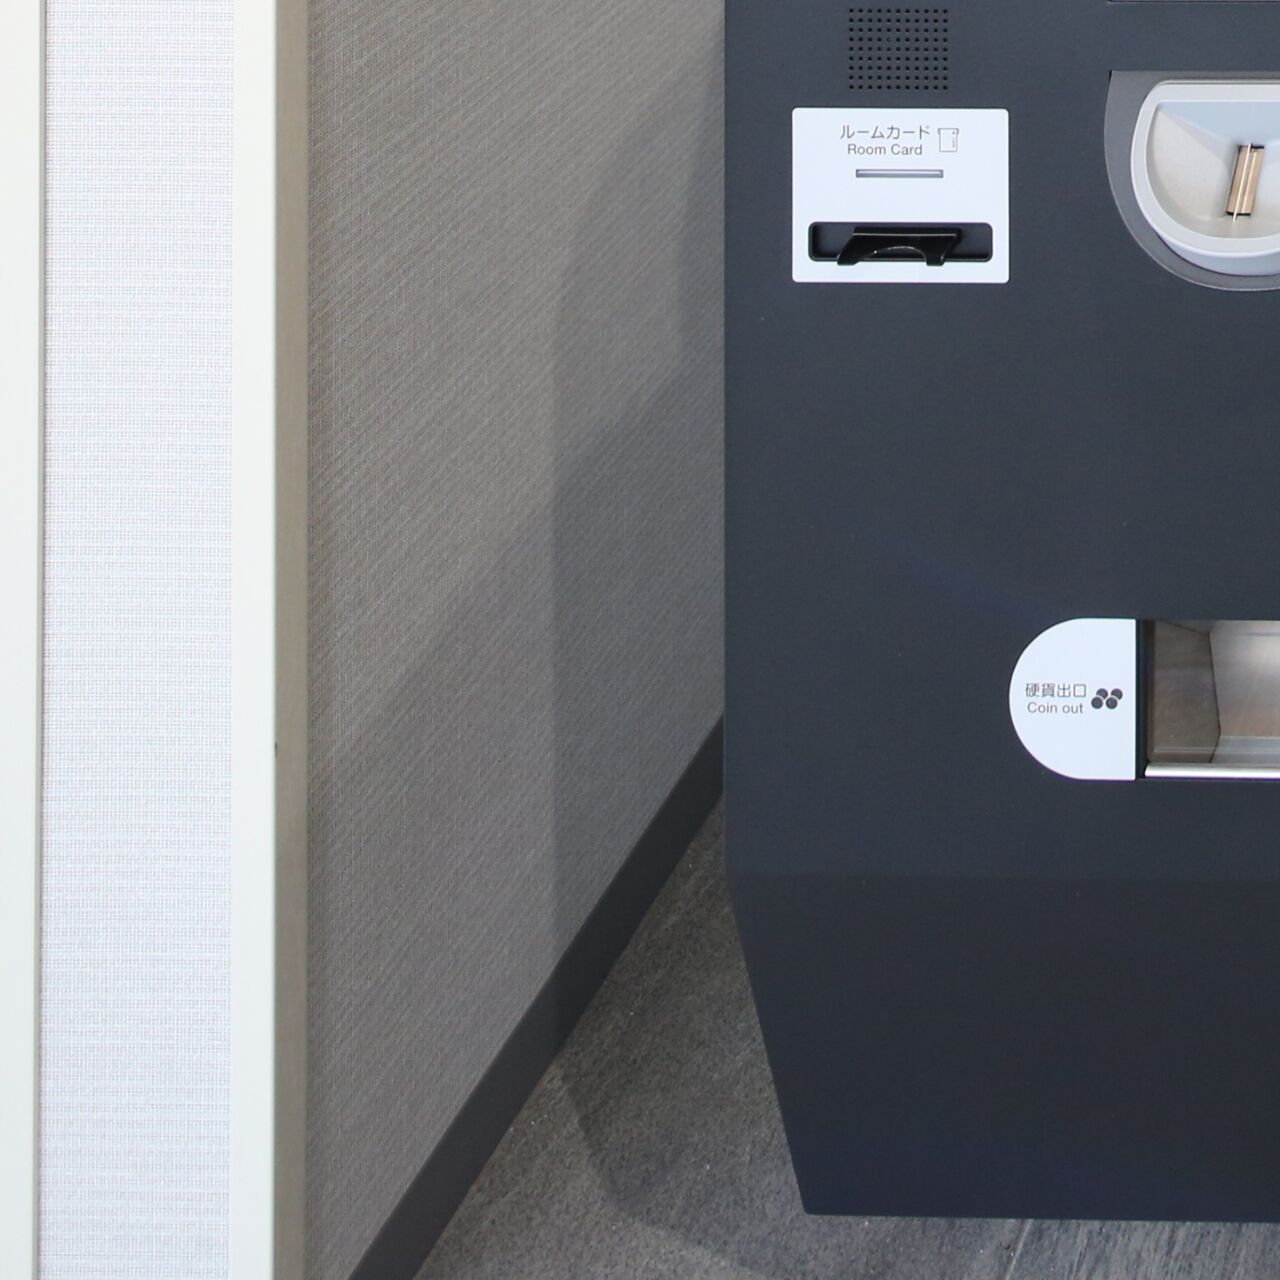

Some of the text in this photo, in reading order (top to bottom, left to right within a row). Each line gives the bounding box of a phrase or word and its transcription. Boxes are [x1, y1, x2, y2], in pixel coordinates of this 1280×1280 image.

[840, 124, 930, 140] ルームカード
[847, 144, 923, 156] Room Card
[1025, 683, 1086, 698] 硬貨出口
[1027, 701, 1084, 714] Coin out
